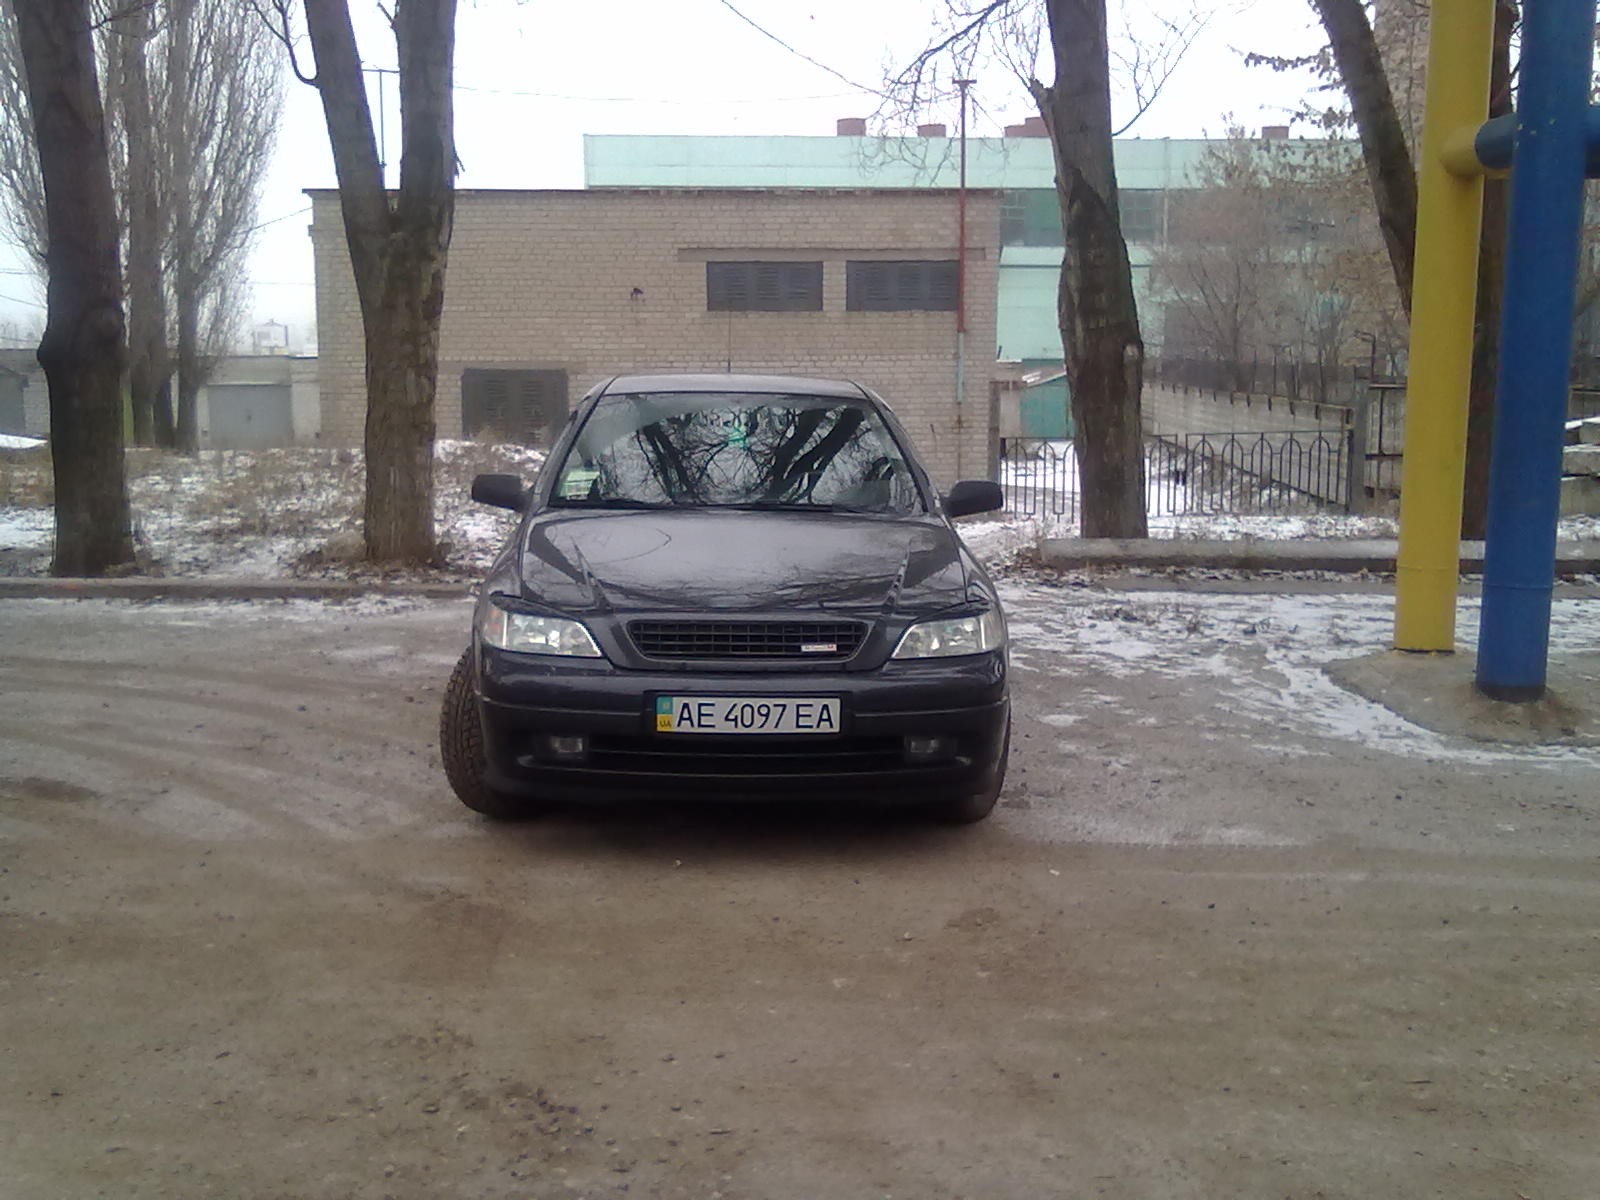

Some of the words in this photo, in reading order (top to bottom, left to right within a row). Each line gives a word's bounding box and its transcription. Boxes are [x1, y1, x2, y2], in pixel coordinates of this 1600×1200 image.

[677, 702, 716, 728] AE
[724, 703, 787, 729] 4097
[795, 703, 834, 729] EA
